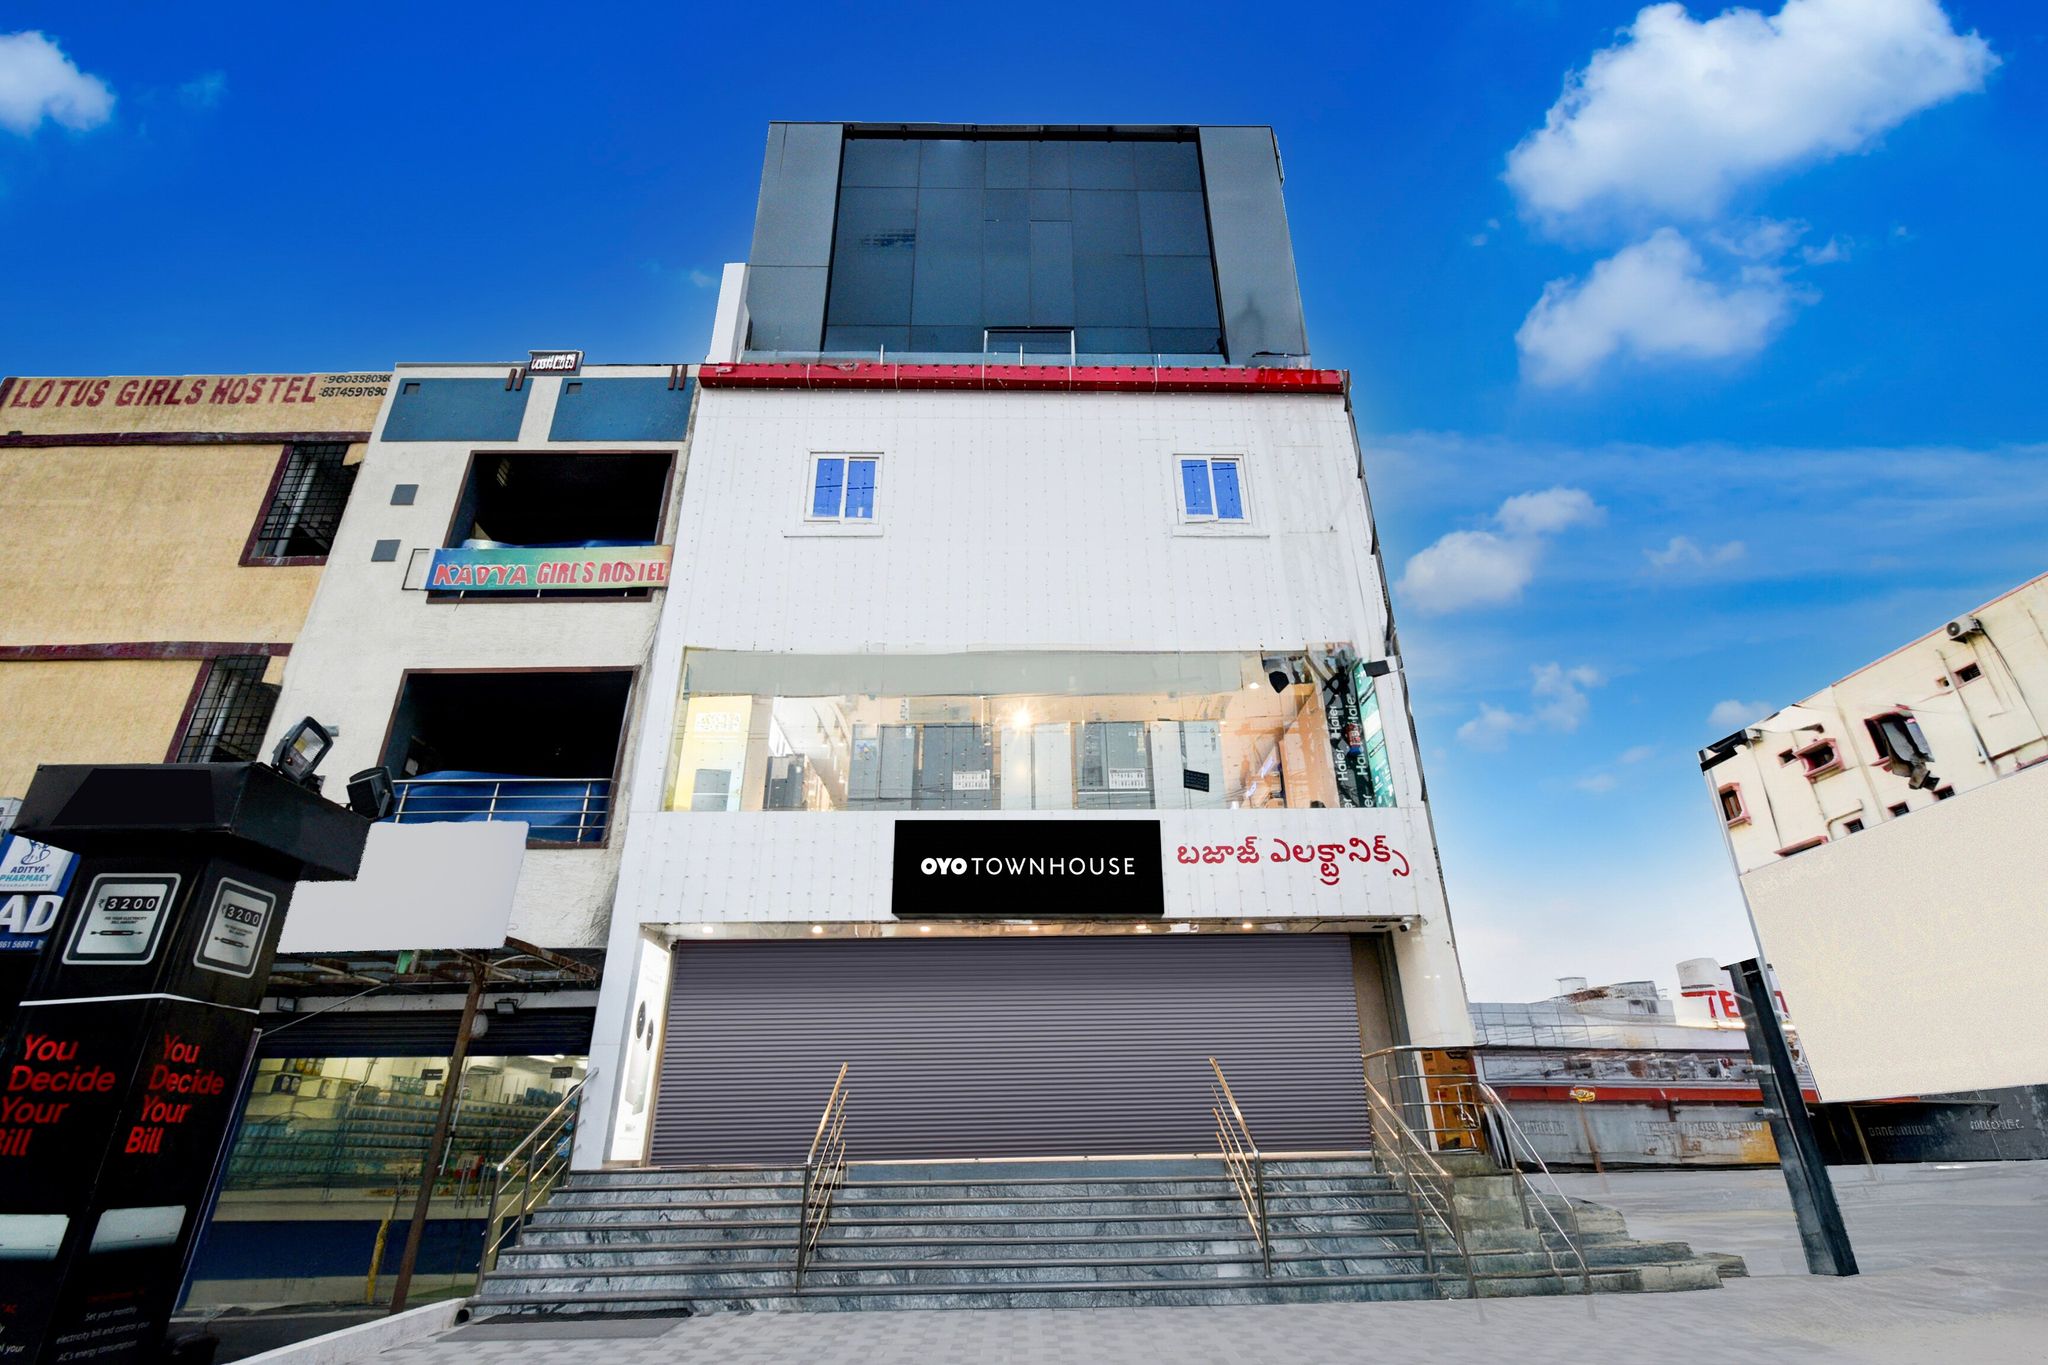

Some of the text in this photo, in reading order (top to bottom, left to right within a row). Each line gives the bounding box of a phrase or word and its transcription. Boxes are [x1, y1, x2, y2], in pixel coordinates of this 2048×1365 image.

[9, 376, 317, 408] LOTUS GIRLS HOSTEL
[1328, 705, 1342, 739] Haier
[1335, 749, 1349, 781] Haier
[921, 857, 1135, 876] OYO TOWNHOUSE
[1177, 835, 1410, 885] బజాజ్ ఎలక్ట్రానిక్స్
[0, 874, 52, 882] PHARMACY
[107, 898, 156, 909] 3200
[228, 907, 259, 925] 3200
[24, 1033, 79, 1061] You
[163, 1032, 200, 1063] You
[7, 1065, 116, 1092] Decide
[148, 1064, 225, 1095] Decide
[0, 1095, 71, 1123] Your
[140, 1095, 192, 1123] Your
[124, 1126, 164, 1154] Bill
